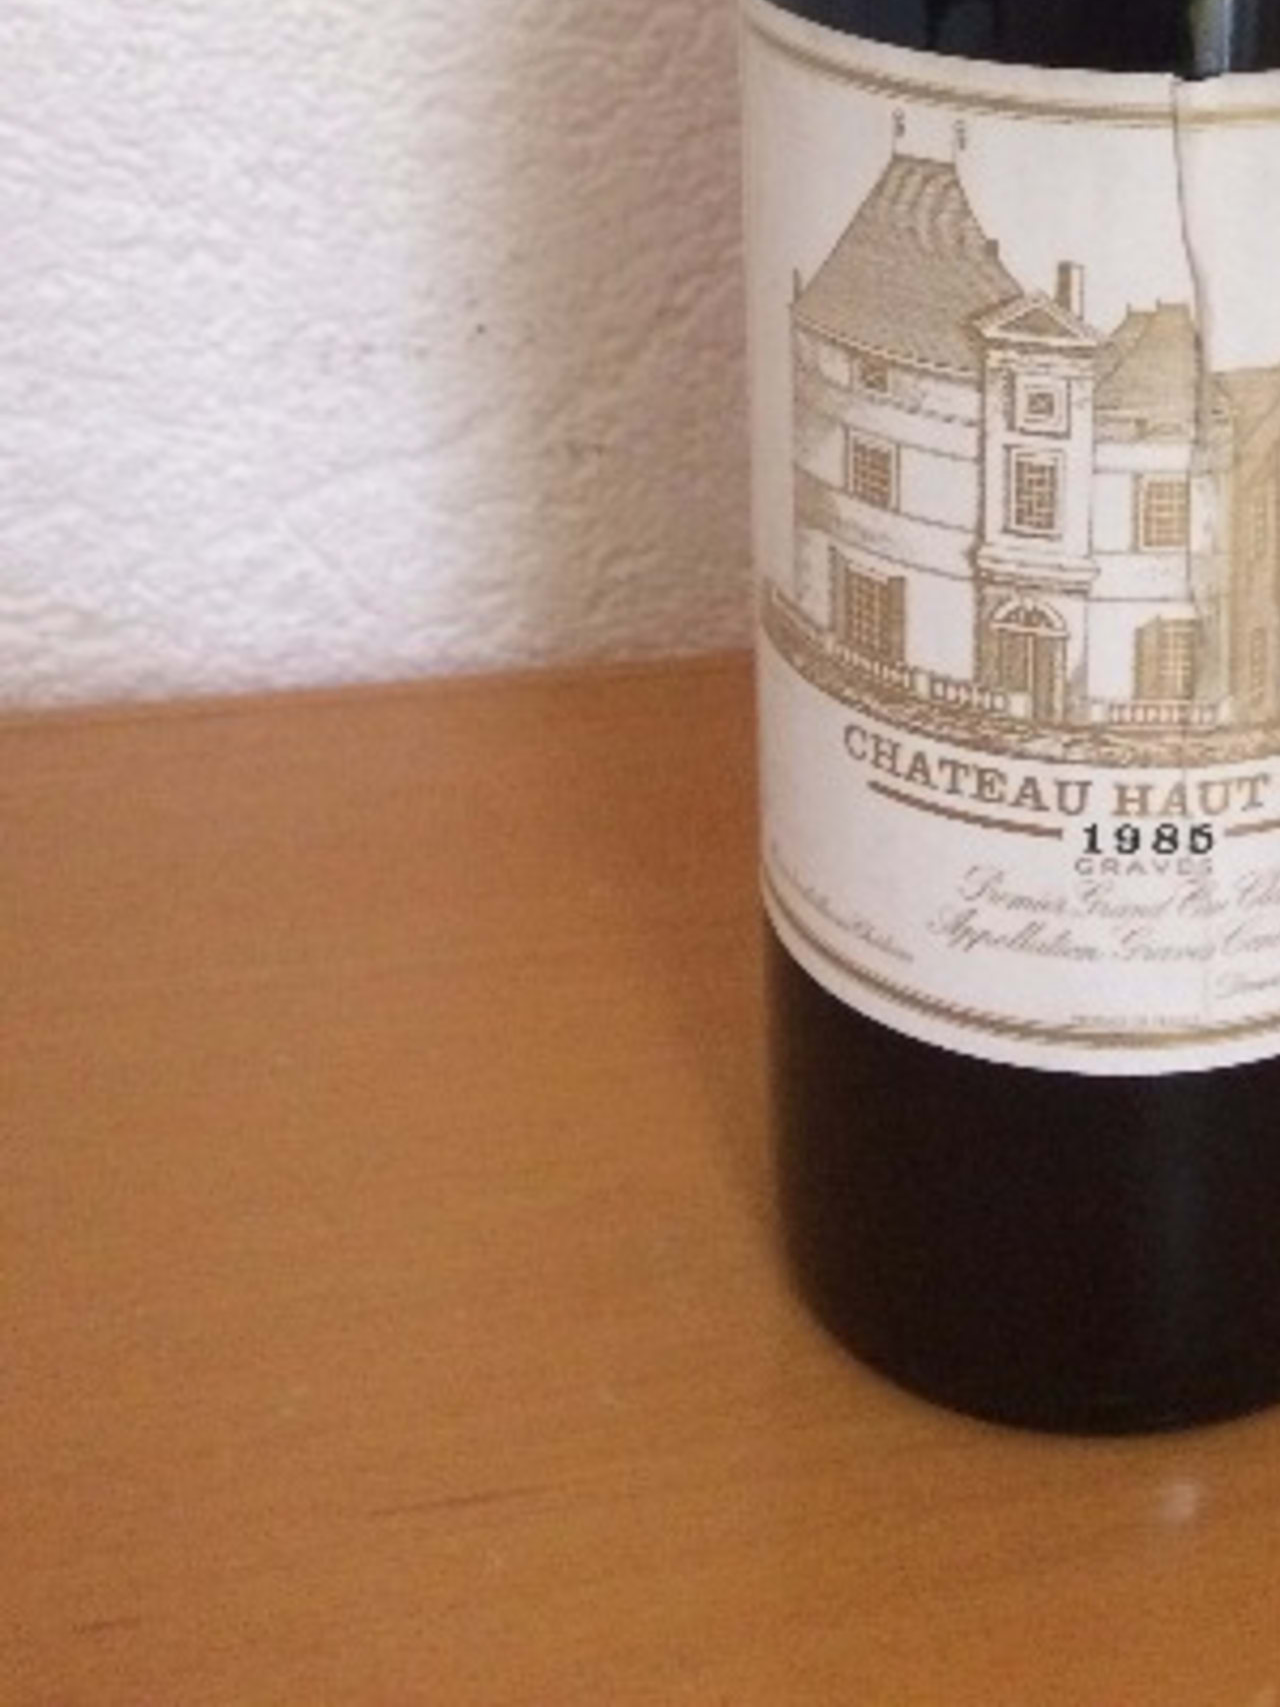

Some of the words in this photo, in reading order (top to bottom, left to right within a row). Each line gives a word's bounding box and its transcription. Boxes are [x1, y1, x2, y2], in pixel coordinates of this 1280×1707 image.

[843, 724, 1093, 817] CHATEAU
[1110, 773, 1269, 818] HAUT
[1082, 821, 1214, 855] 1985
